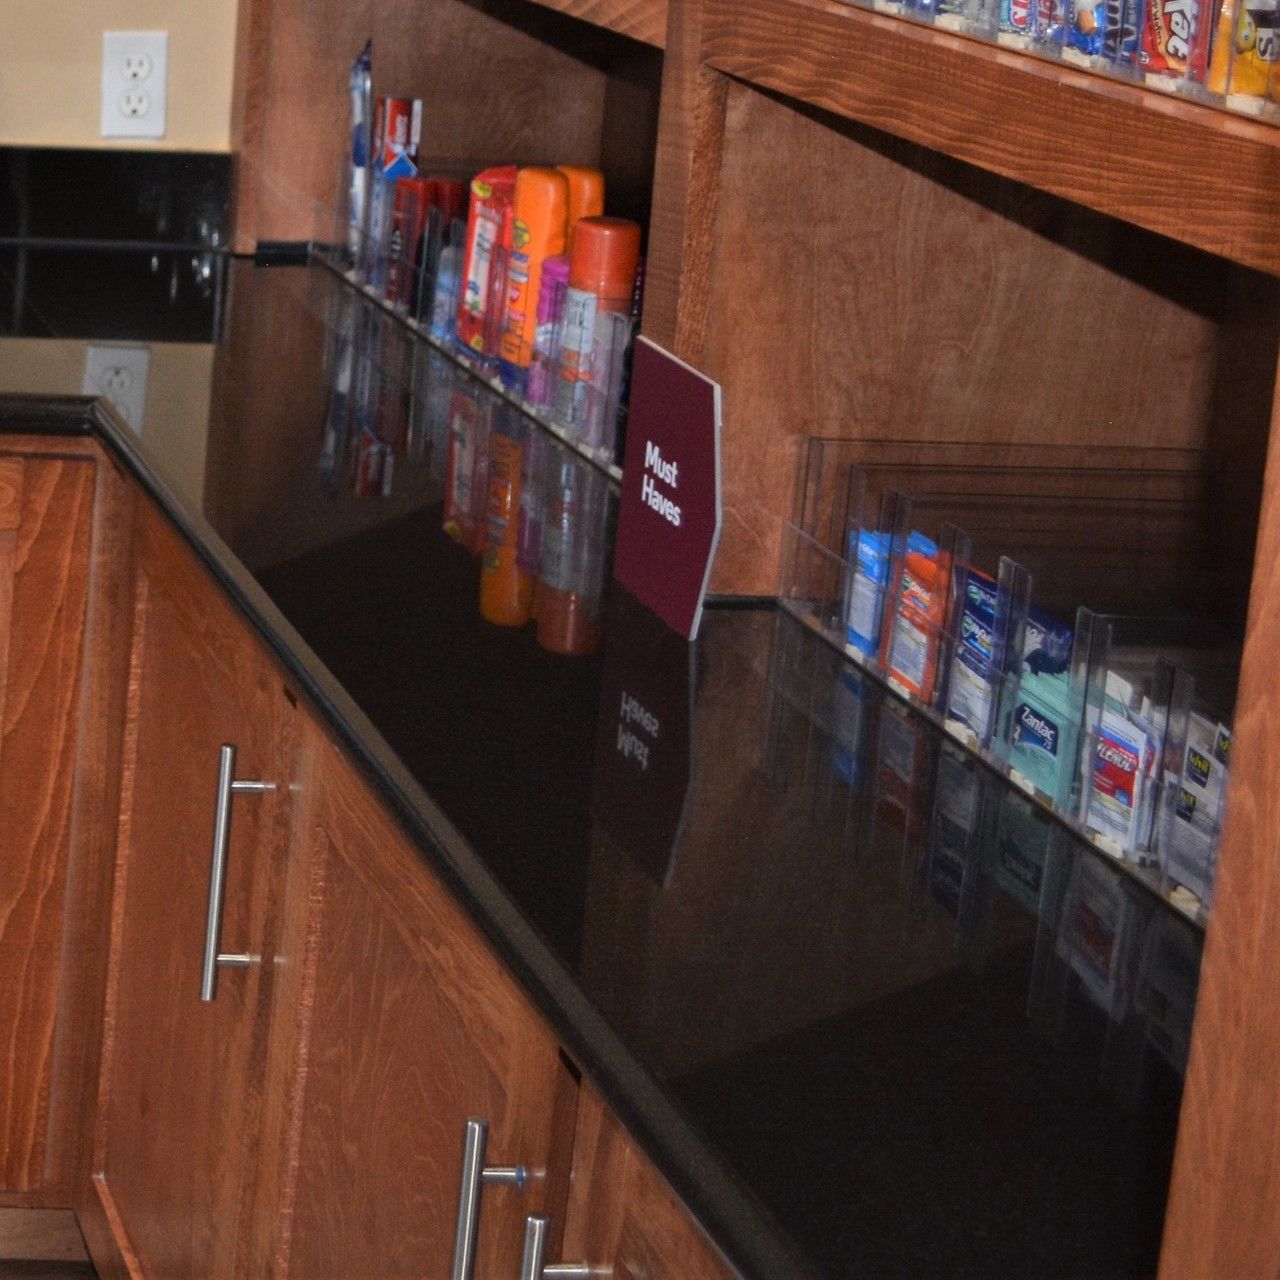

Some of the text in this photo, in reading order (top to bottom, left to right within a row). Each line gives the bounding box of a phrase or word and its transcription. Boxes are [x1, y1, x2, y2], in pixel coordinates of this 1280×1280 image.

[645, 440, 679, 489] Must
[641, 473, 681, 527] Haves
[1021, 705, 1056, 741] Zantac
